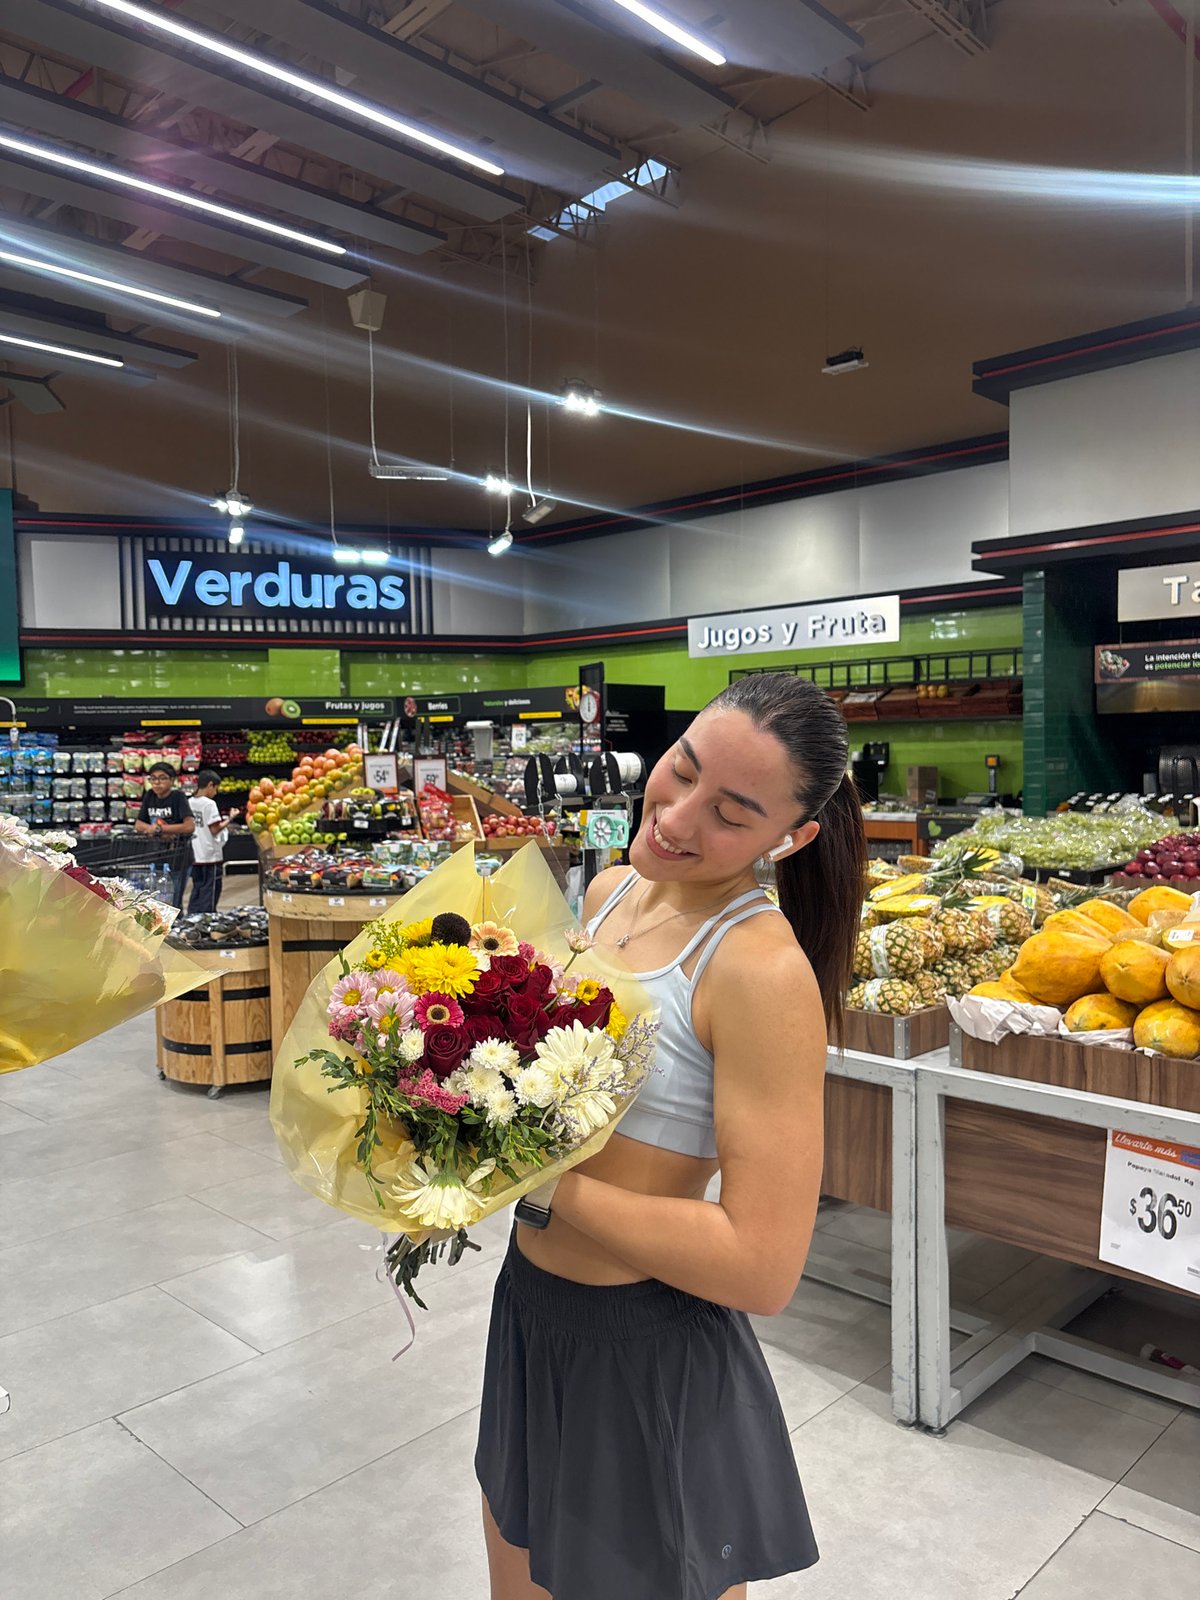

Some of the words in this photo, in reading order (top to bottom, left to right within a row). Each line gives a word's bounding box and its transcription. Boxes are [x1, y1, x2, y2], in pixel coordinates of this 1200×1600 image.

[147, 559, 406, 610] Verduras
[697, 624, 772, 651] Jugos
[781, 621, 798, 646] y
[807, 611, 886, 640] Fruta
[1144, 654, 1154, 662] La
[1155, 652, 1190, 662] intención
[325, 702, 352, 710] Frutas
[354, 703, 360, 711] y
[361, 702, 385, 711] jugos
[428, 702, 448, 711] Berries
[1114, 1133, 1153, 1152] Llevarte
[1153, 1146, 1178, 1158] más
